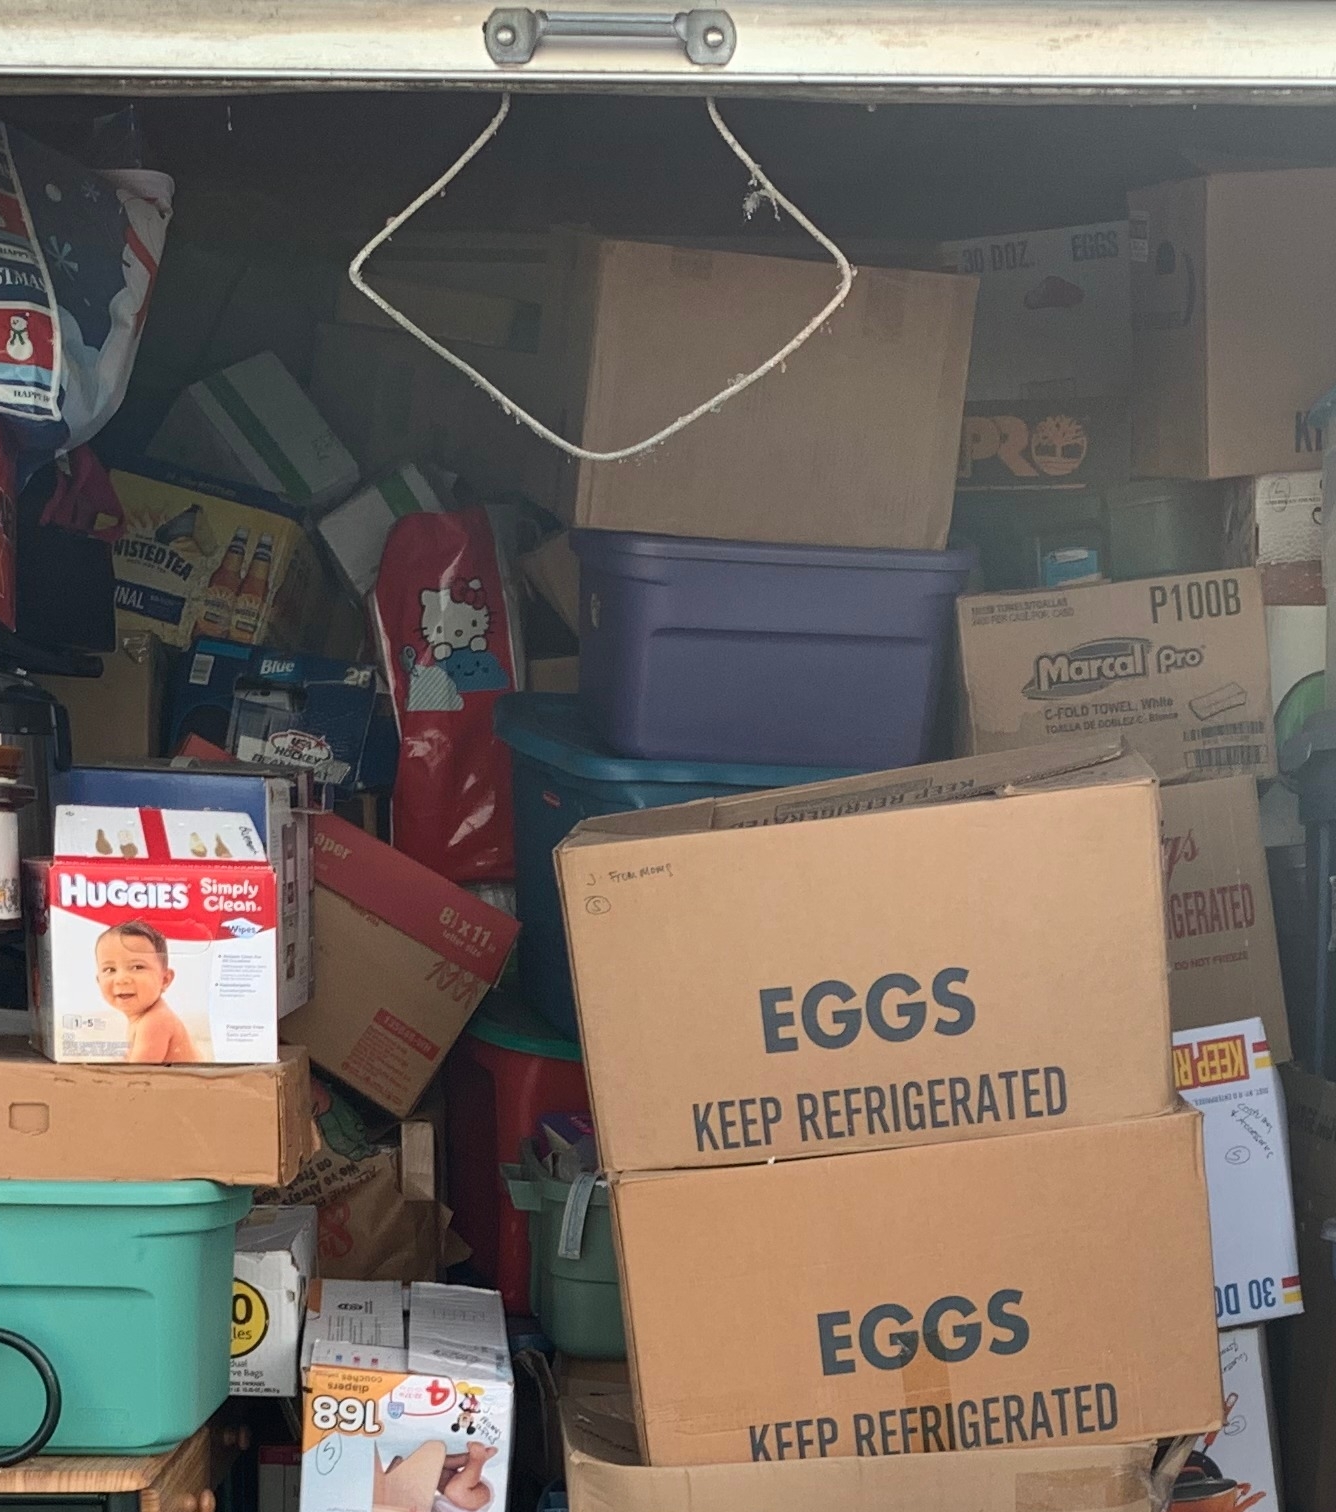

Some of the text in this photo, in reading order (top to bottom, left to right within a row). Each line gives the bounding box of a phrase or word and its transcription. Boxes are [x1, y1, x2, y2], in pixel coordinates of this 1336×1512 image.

[164, 545, 194, 582] TEA
[1149, 577, 1242, 625] P100B
[259, 659, 296, 676] Blue
[1037, 644, 1203, 692] Marcal Pro
[1044, 705, 1090, 721] C-FOLD
[274, 746, 324, 764] HOCKEY
[313, 831, 353, 861] aper
[59, 872, 259, 910] HUGGIES Simply
[226, 919, 257, 935] Wipes
[758, 966, 977, 1055] EGGS
[1198, 1037, 1247, 1083] KEEP
[692, 1065, 1068, 1152] KEEP REFRIGERATED
[816, 1288, 1031, 1376] EGGS
[327, 1381, 370, 1394] diapers
[425, 1379, 451, 1407] 4
[311, 1393, 382, 1434] 168
[749, 1381, 1120, 1464] KEEP REFRIGERATED
